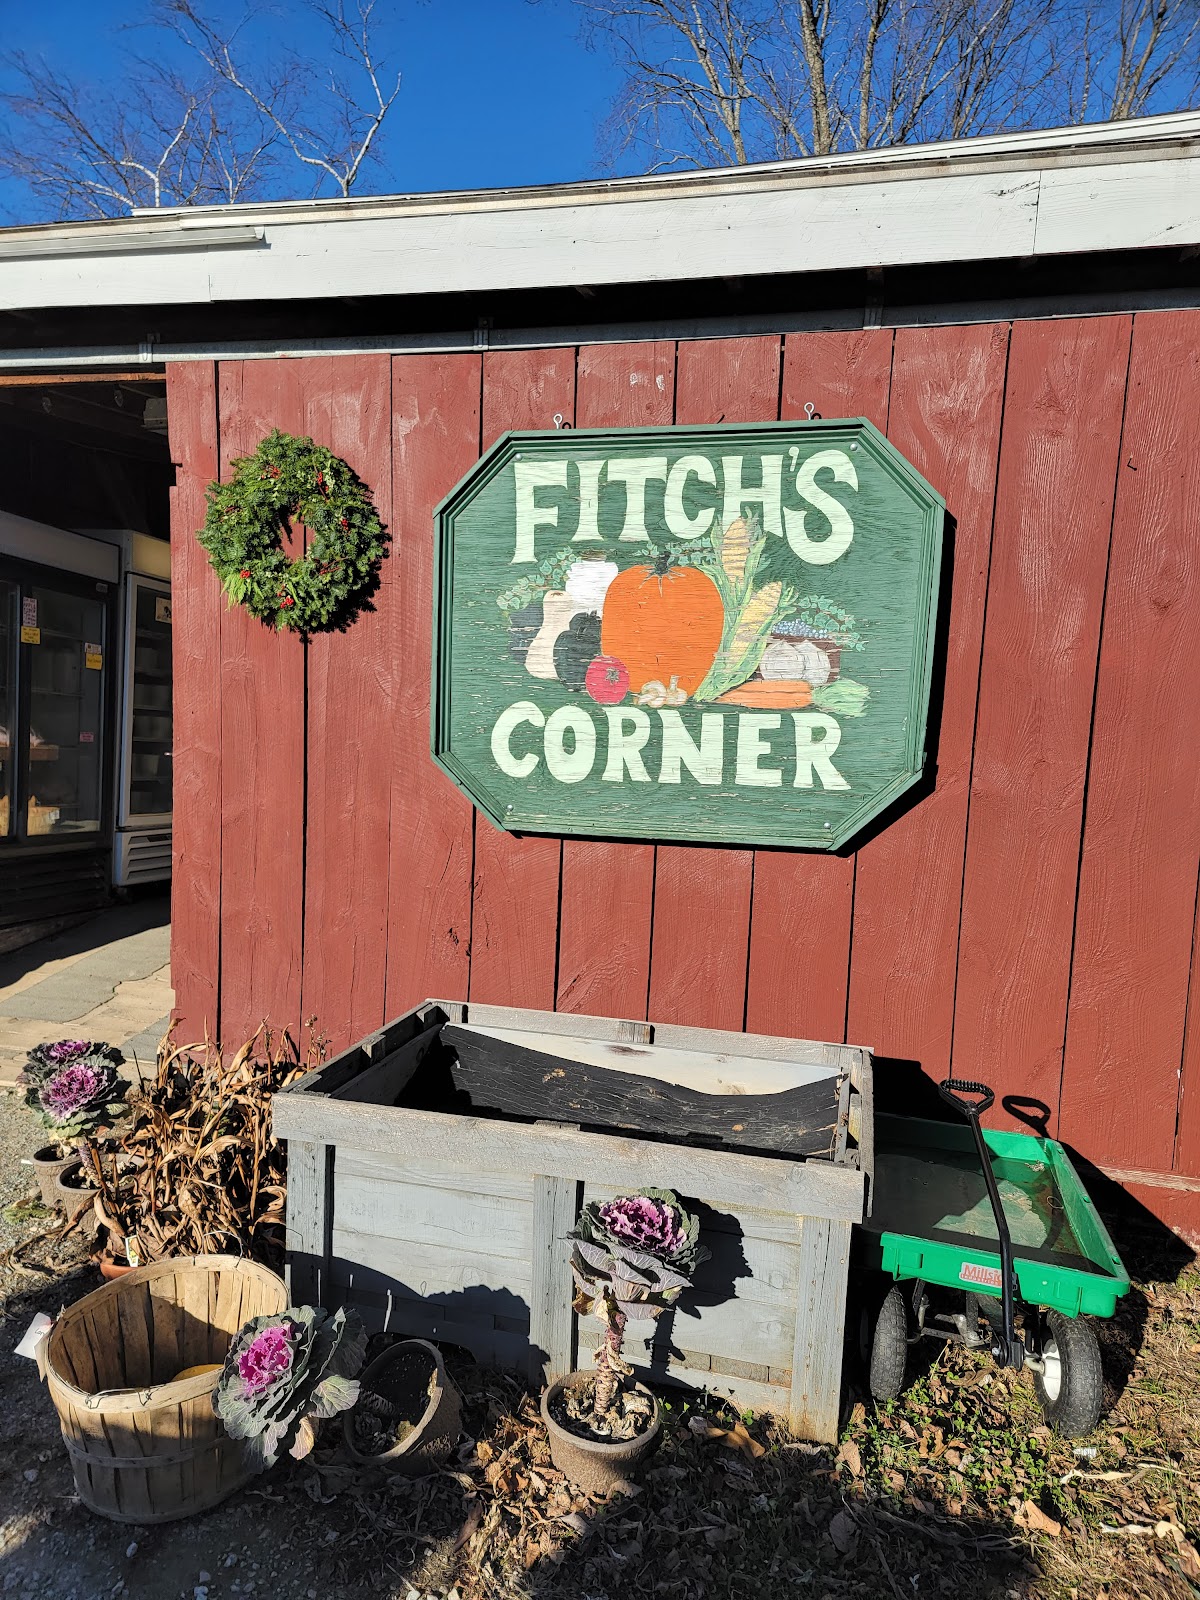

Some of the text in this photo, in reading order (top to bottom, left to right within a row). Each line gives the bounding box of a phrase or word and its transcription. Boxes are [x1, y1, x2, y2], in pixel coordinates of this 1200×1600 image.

[511, 446, 859, 565] FITCH'S
[490, 700, 852, 790] CORNER
[964, 1264, 1002, 1281] Millsi
